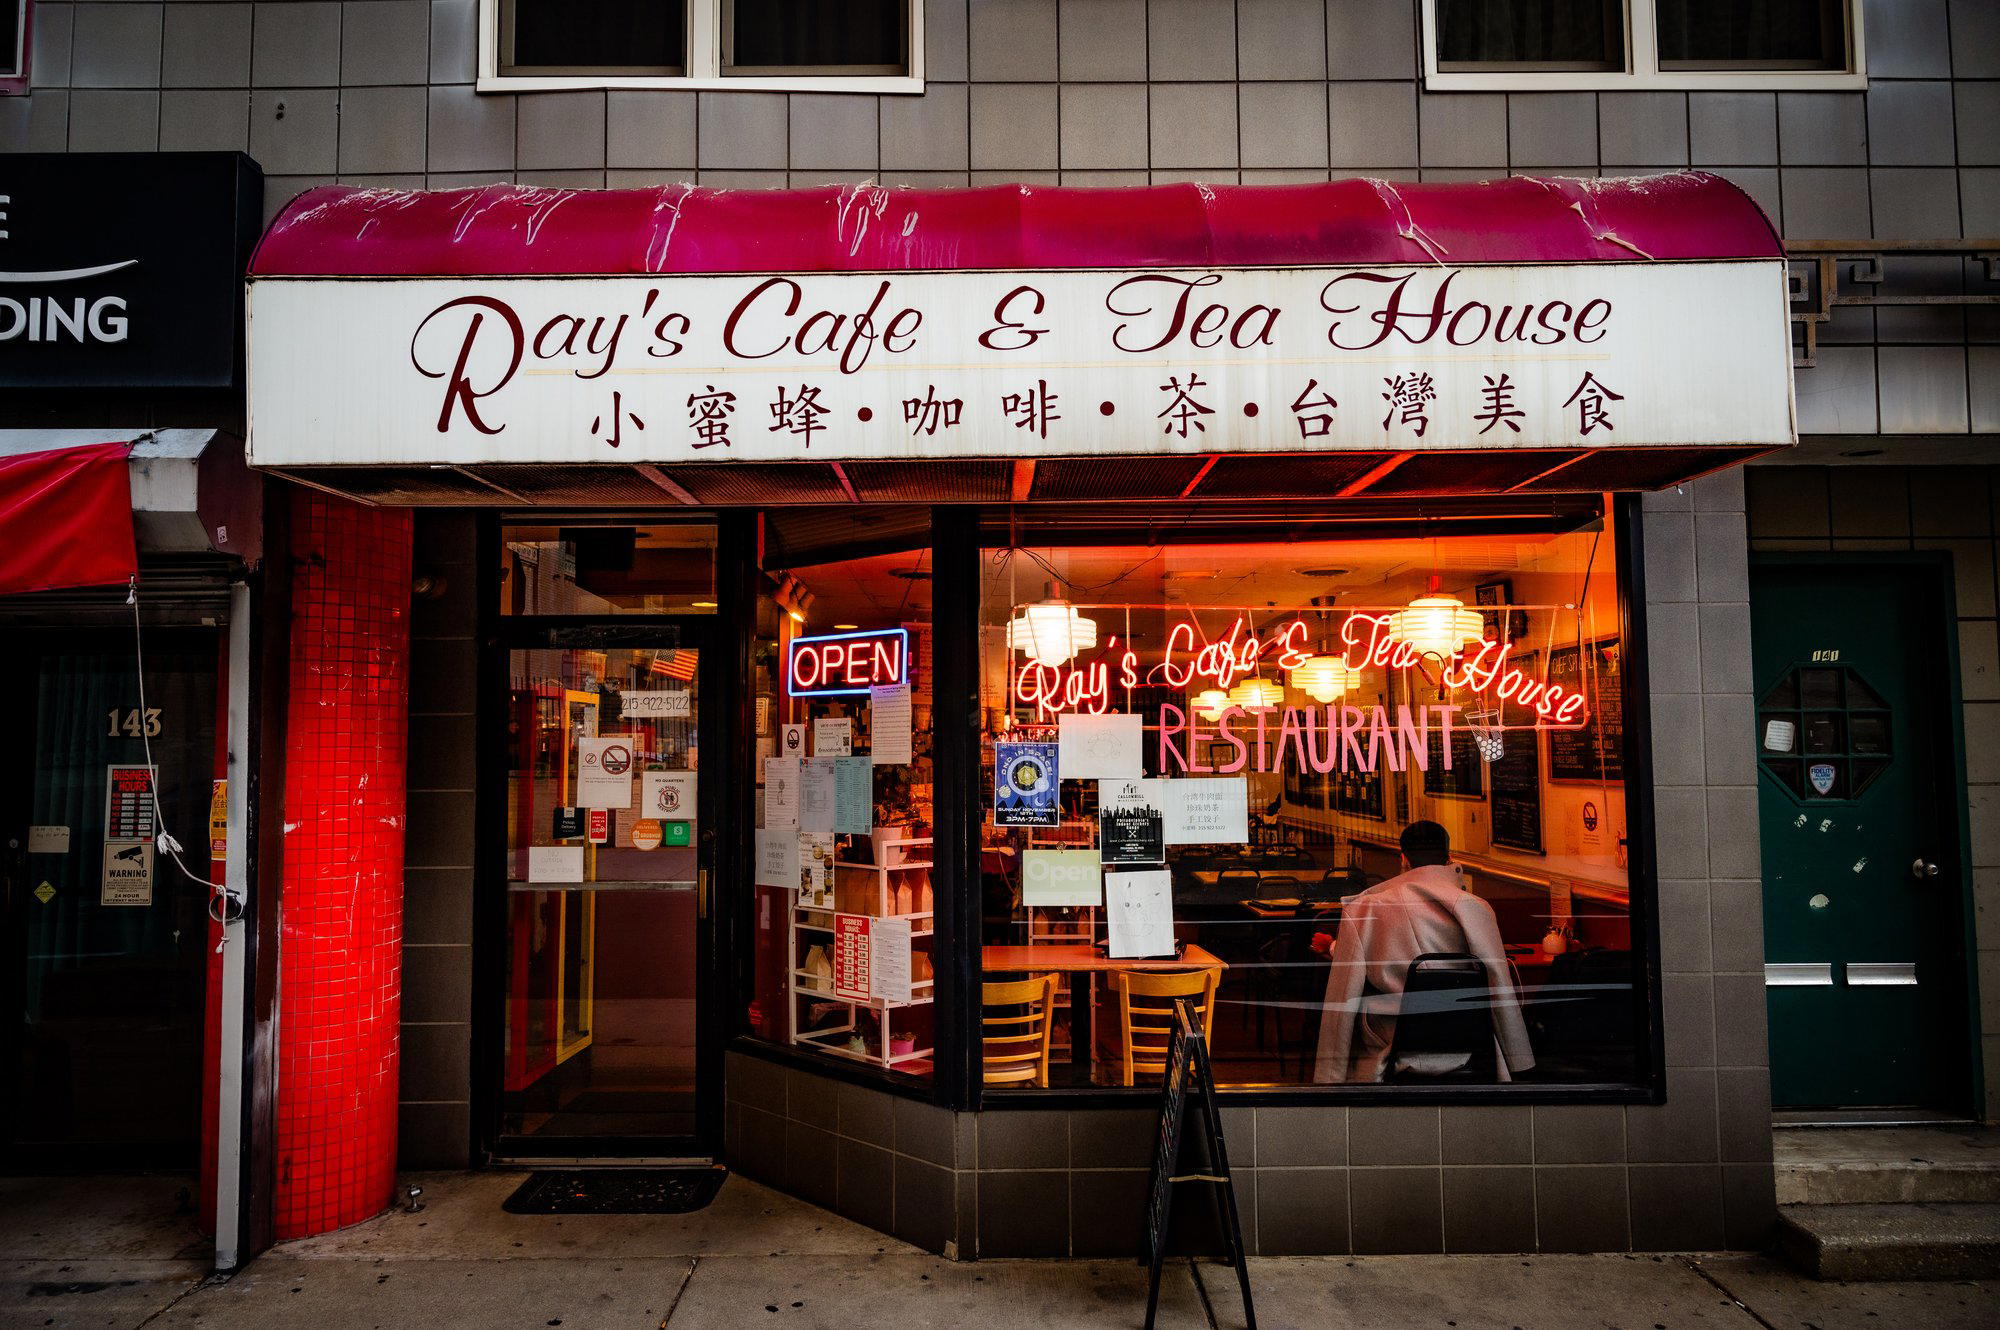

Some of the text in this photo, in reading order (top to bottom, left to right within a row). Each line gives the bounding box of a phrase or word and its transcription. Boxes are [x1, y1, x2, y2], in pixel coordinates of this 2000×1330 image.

[410, 270, 1614, 435] Ray's Cafe & Tea House
[793, 639, 900, 687] OPEN
[1017, 635, 1138, 723] Ray's
[1164, 617, 1260, 688] Cafe
[1278, 621, 1313, 670] &
[1341, 613, 1421, 672] Tea
[1443, 633, 1585, 722] House
[1812, 650, 1839, 662] 141
[622, 696, 689, 711] 215-922-5122
[108, 707, 162, 737] 143
[1159, 703, 1462, 774] RESTAURANT
[109, 869, 148, 878] WARNING
[1027, 858, 1097, 888] Open
